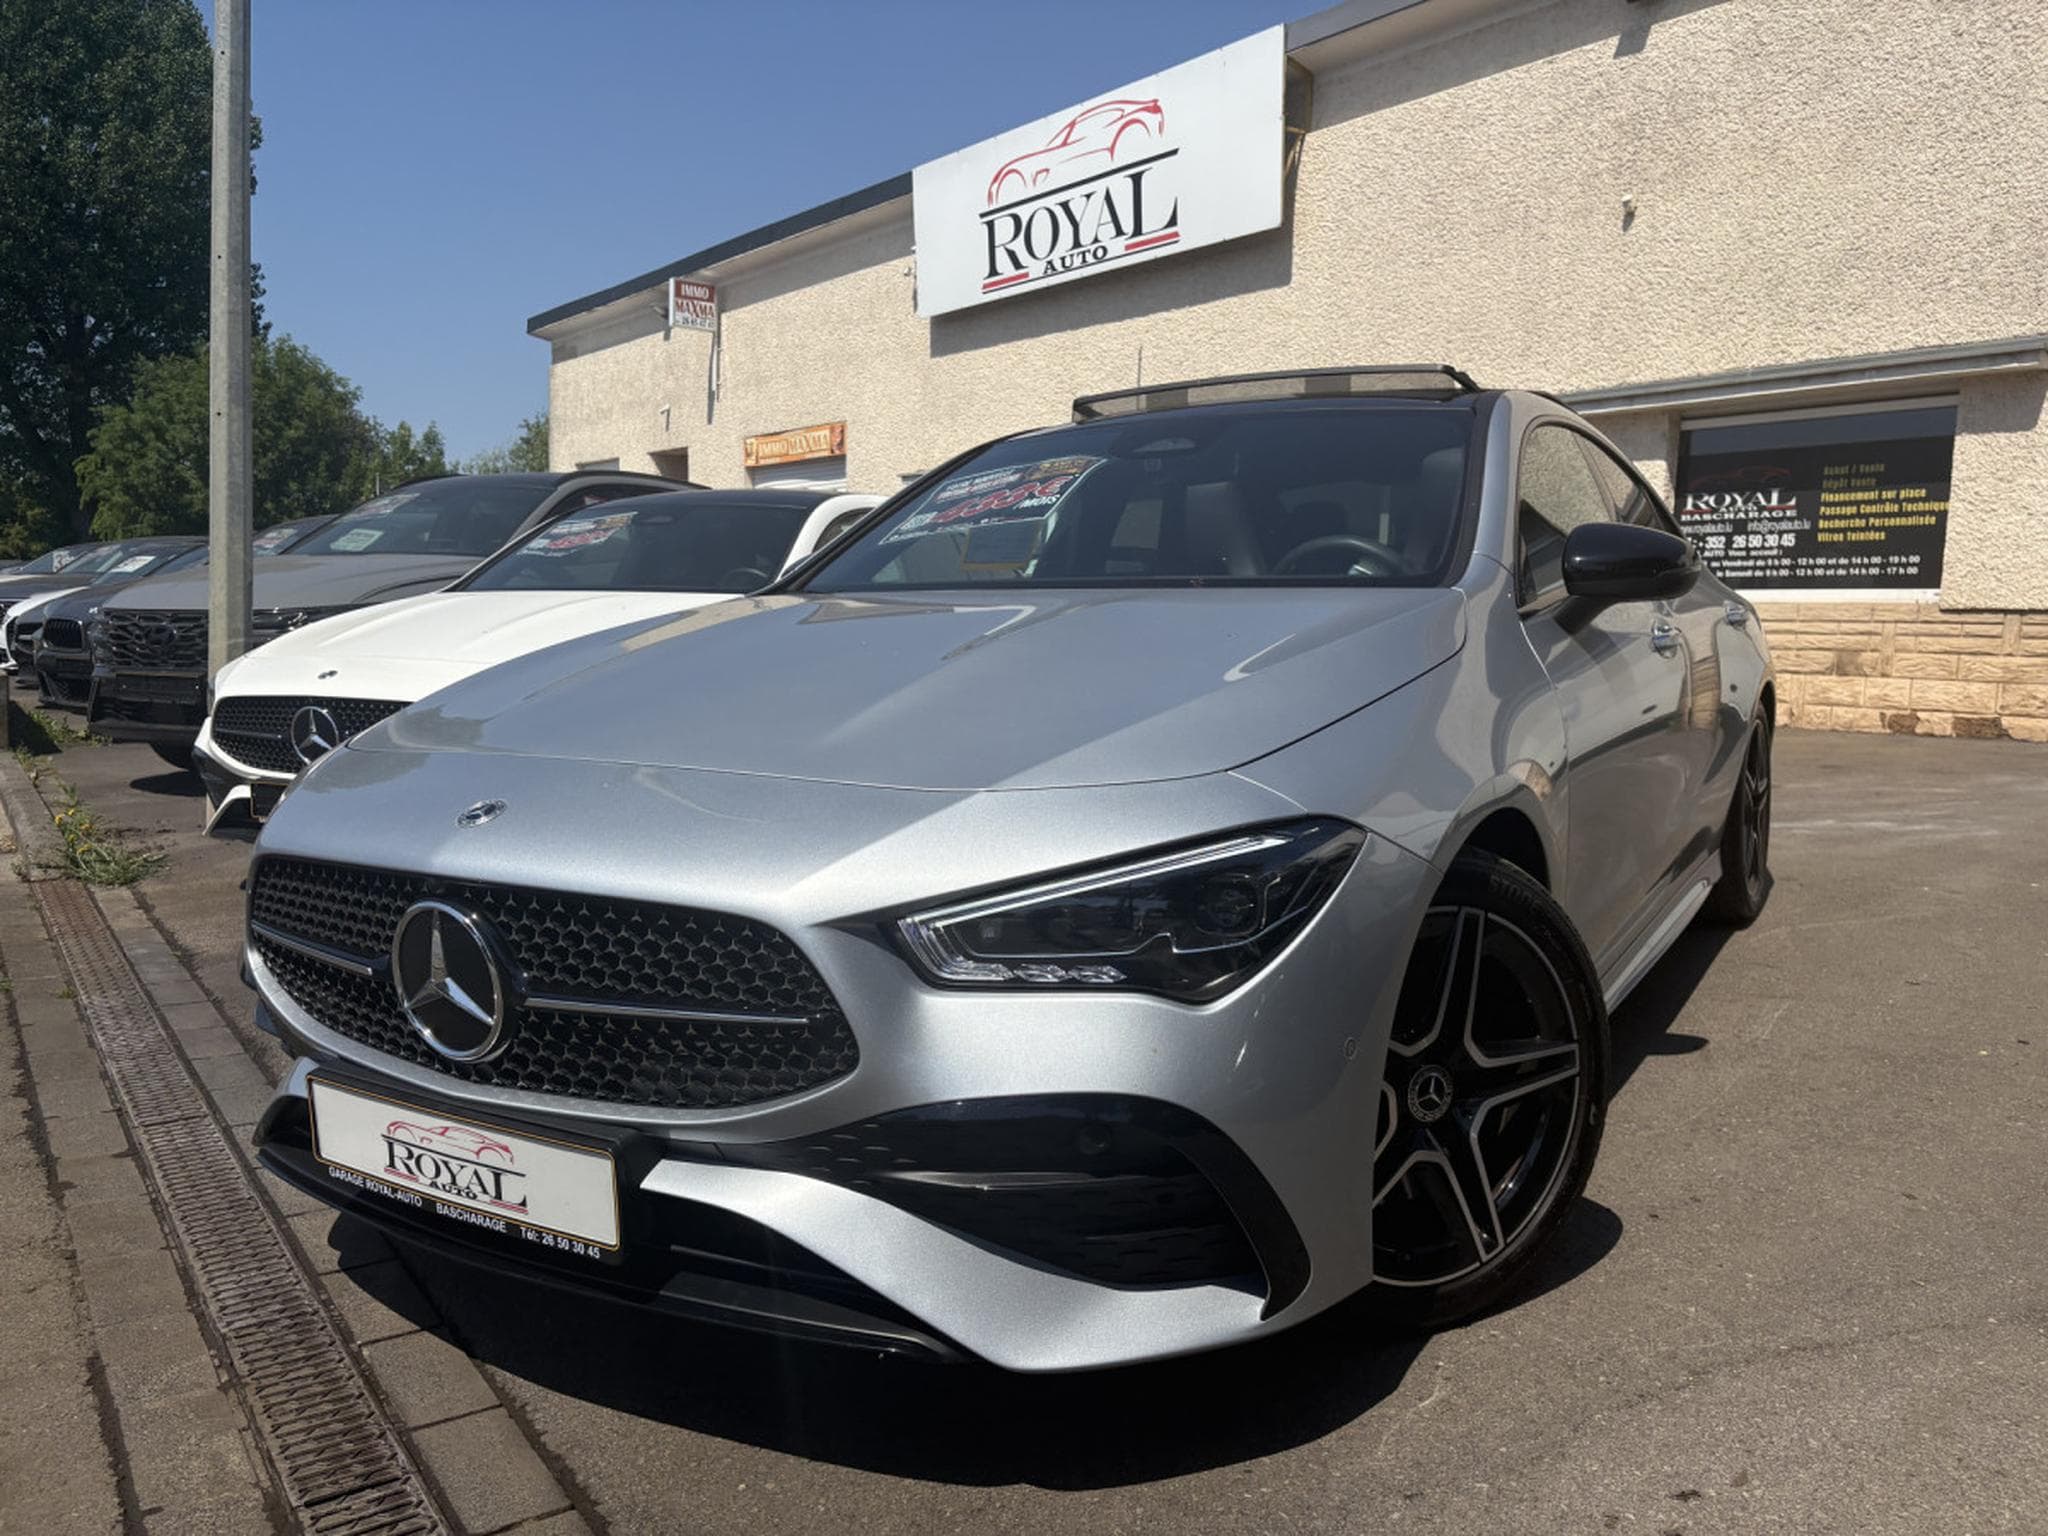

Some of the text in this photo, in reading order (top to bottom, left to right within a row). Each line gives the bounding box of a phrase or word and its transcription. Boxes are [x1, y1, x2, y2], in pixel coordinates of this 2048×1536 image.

[982, 167, 1178, 279] ROYAL
[1043, 246, 1108, 274] AUTO
[681, 283, 709, 299] IMMO
[1684, 488, 1797, 510] ROYAL
[1821, 487, 1927, 502] Financement sur place
[1681, 510, 1797, 521] BASCHARAGE
[1720, 502, 1758, 514] AUTO
[1820, 505, 1858, 516] Passage
[1819, 518, 1866, 529] Recherche
[1732, 534, 1747, 548] 26
[1748, 534, 1762, 548] 50
[1764, 534, 1779, 548] 30
[1780, 533, 1796, 547] 45
[1703, 550, 1725, 558] AUTO
[1797, 557, 1807, 566] 12
[1815, 557, 1827, 566] 00
[1828, 557, 1837, 565] et
[1838, 557, 1849, 565] de
[1851, 556, 1862, 564] 14
[1870, 556, 1882, 564] 00
[1908, 555, 1920, 564] 00
[1779, 568, 1790, 577] 00
[1796, 568, 1806, 576] 12
[1814, 567, 1825, 576] 00
[1826, 568, 1835, 576] et
[1836, 567, 1847, 576] de
[1849, 567, 1859, 575] 14
[1868, 567, 1880, 575] 00
[1886, 566, 1898, 575] 17
[1906, 566, 1919, 575] 00
[383, 1138, 527, 1207] ROYAL
[430, 1181, 479, 1200] AUTO
[329, 1166, 365, 1187] GARAGE
[365, 1178, 422, 1207] ROYAL-AUTO
[436, 1202, 508, 1233] BASCHARAGE
[542, 1233, 555, 1247] 26
[557, 1237, 570, 1251] 50
[572, 1241, 585, 1255] 30
[587, 1246, 601, 1259] 45
